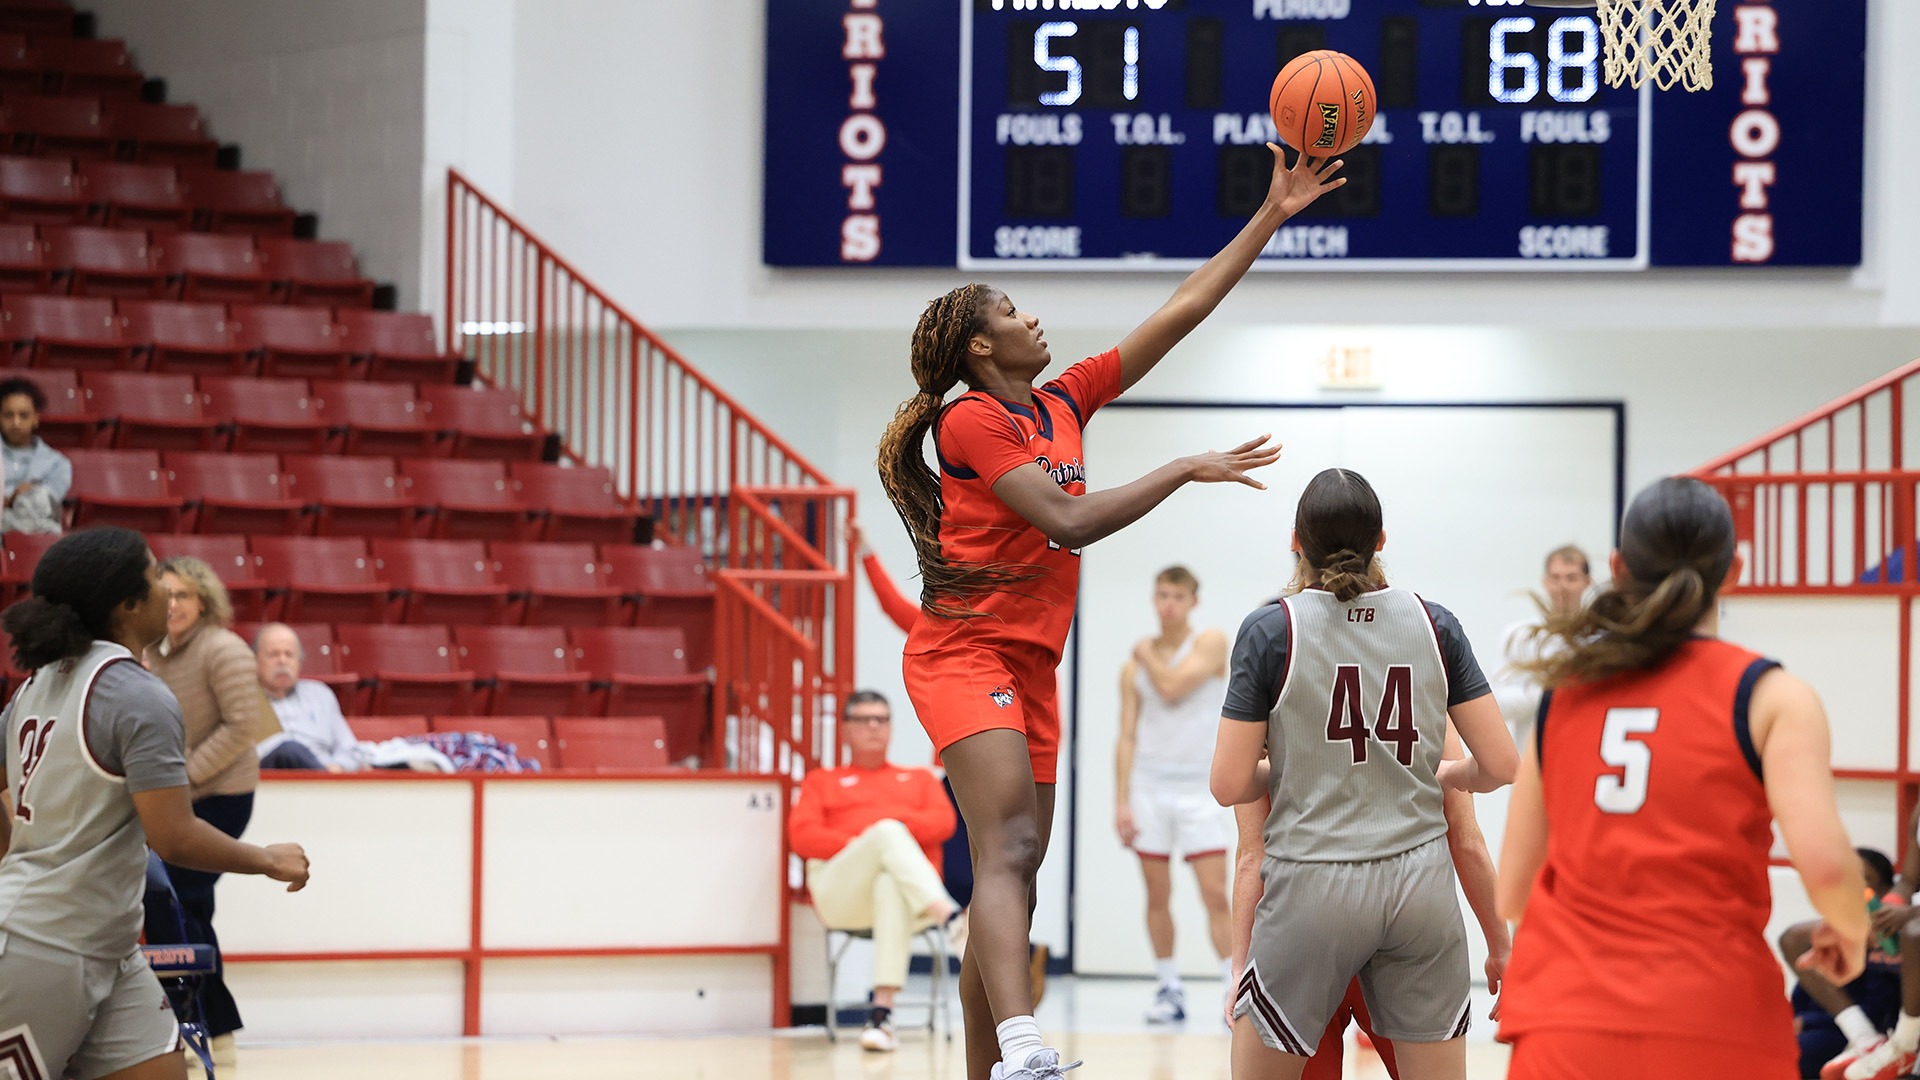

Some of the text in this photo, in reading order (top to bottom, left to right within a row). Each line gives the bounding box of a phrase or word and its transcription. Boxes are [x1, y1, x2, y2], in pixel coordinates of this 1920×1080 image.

[1489, 16, 1599, 102] 68
[839, 0, 886, 261] RIOTS
[996, 113, 1083, 146] FOULS
[1110, 113, 1187, 145] T.O.L.
[1313, 103, 1340, 148] NAIA
[1418, 111, 1496, 144] T.O.L.
[1520, 110, 1611, 144] FOULS
[994, 225, 1082, 258] SCORE
[1518, 225, 1609, 258] SCORE
[1347, 608, 1376, 623] LTB
[1325, 663, 1421, 768] 44
[1593, 706, 1660, 815] 5
